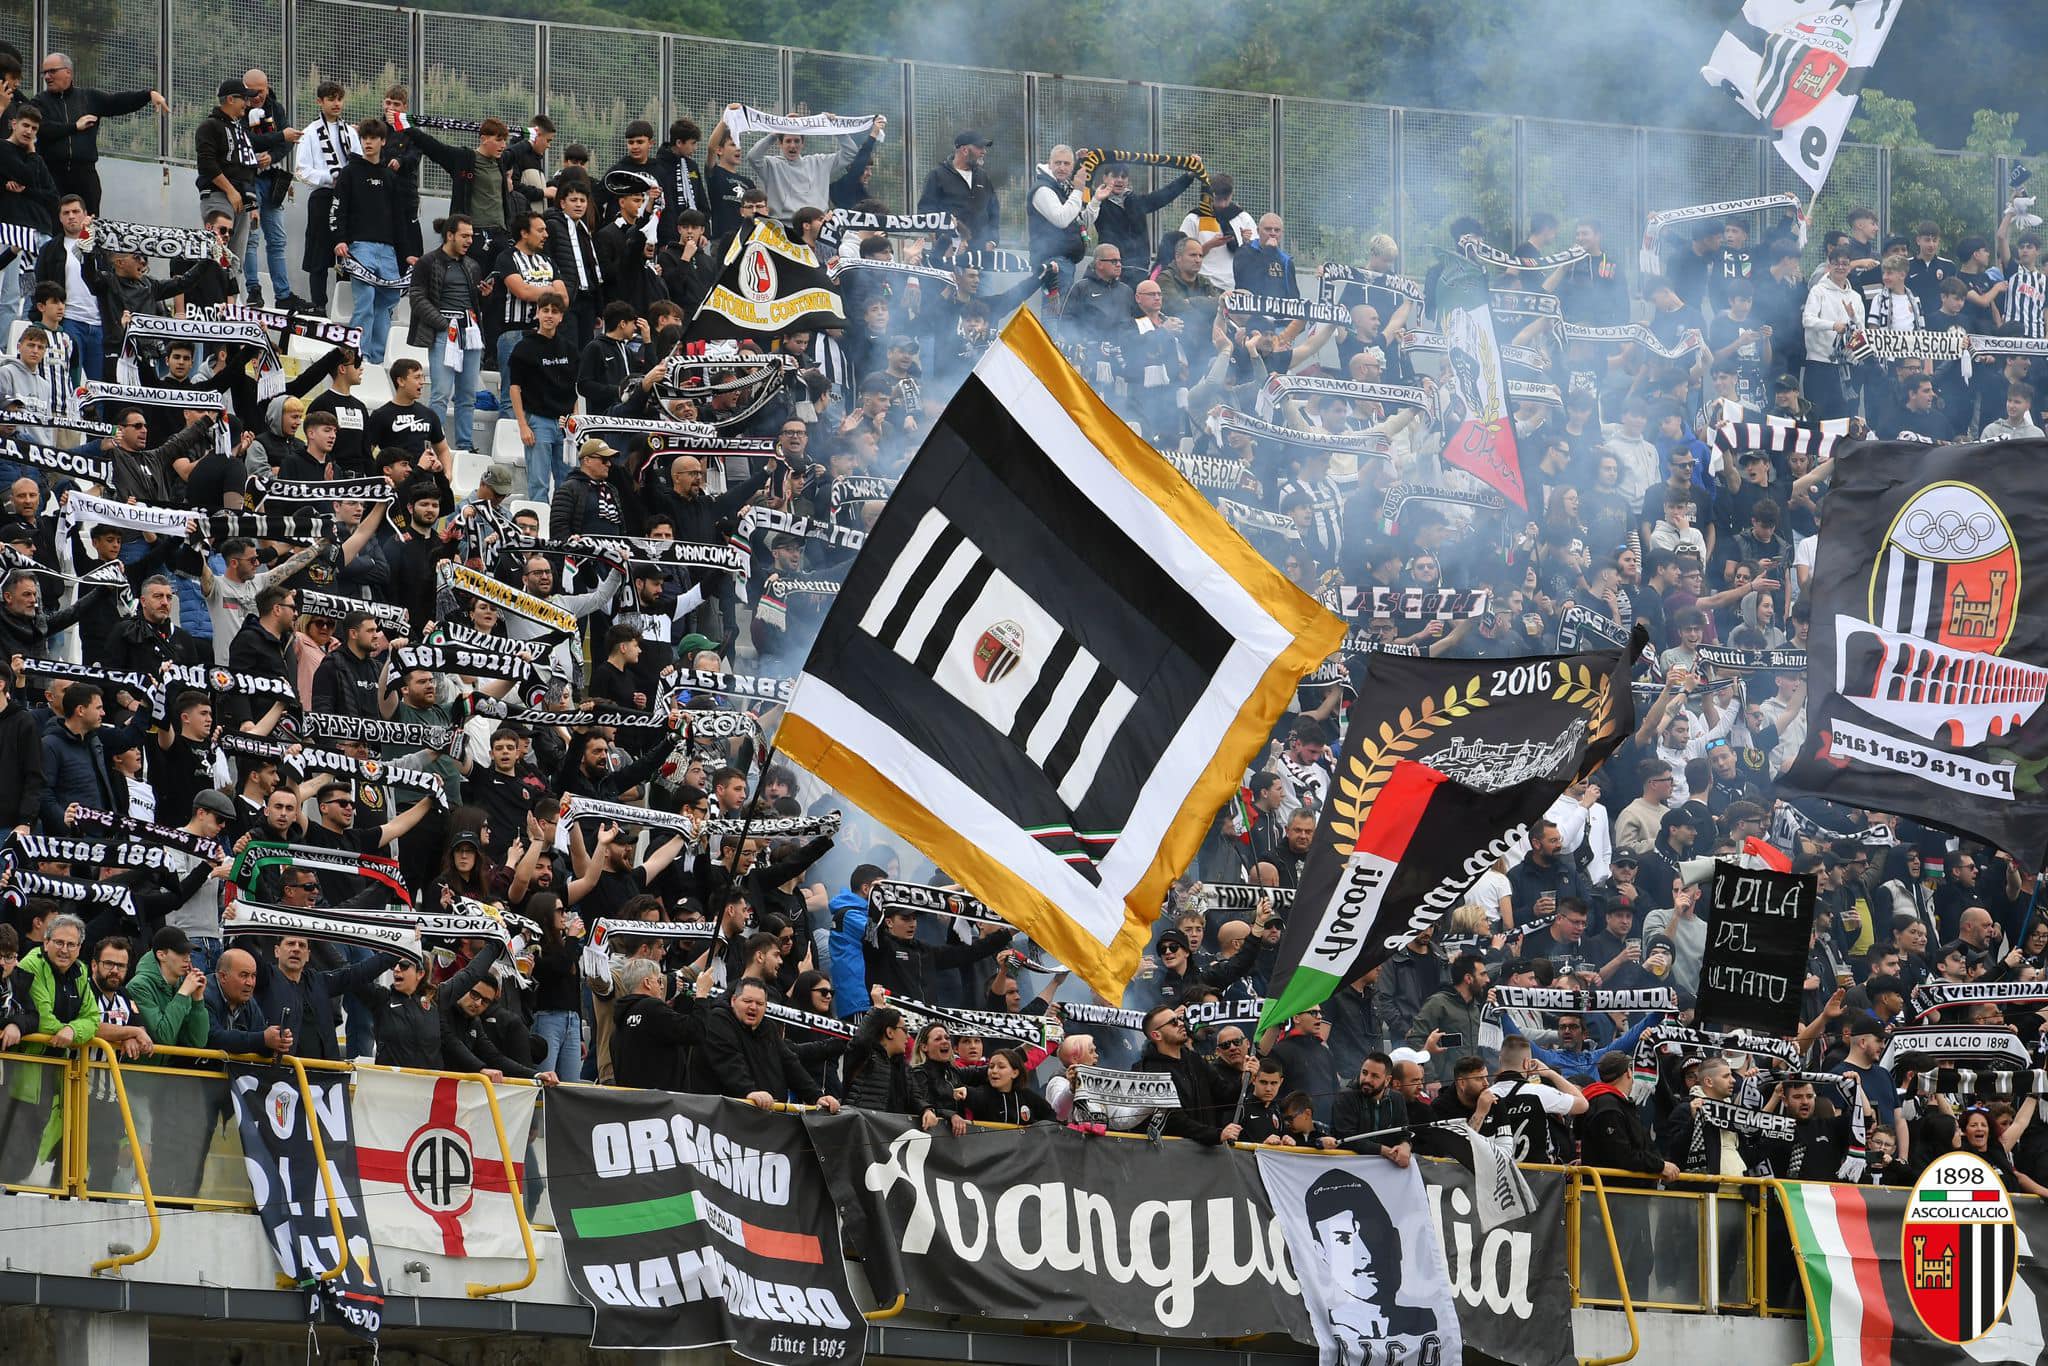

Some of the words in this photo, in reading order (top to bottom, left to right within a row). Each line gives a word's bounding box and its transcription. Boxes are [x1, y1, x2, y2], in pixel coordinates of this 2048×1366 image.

[121, 222, 189, 241] FORZA
[101, 233, 208, 260] ASCOLI
[129, 315, 178, 333] ASCOLI
[181, 323, 236, 336] CALCIO
[1867, 335, 1909, 352] FORZA
[1913, 336, 1961, 355] ASCOLI
[1984, 339, 2023, 349] ASCOLI
[128, 386, 167, 401] SIAMO
[168, 390, 184, 401] LA
[1315, 379, 1357, 392] SIAMO
[1361, 384, 1377, 394] LA
[1379, 386, 1424, 401] STORIA
[396, 415, 415, 424] JUST
[668, 437, 776, 452] DECENNALE
[29, 445, 107, 481] ASCOLI
[1192, 462, 1241, 484] ASCOLI
[79, 499, 126, 519] REGINA
[128, 509, 165, 525] DELLE
[302, 604, 347, 620] BIANCO
[379, 619, 411, 636] NERO
[1490, 660, 1552, 697] 2016
[313, 712, 422, 745] BRIGATA
[250, 911, 303, 927] ASCOLI
[433, 918, 500, 931] STORIA
[1714, 920, 1757, 953] DEL
[1894, 1037, 1928, 1050] ASCOLI
[1935, 1036, 1981, 1048] CALCIO
[1986, 1037, 2010, 1049] 1898
[1077, 1078, 1123, 1094] FORZA
[1761, 1129, 1795, 1142] NERO
[592, 1114, 791, 1206] ORGASMO
[769, 1334, 807, 1357] since
